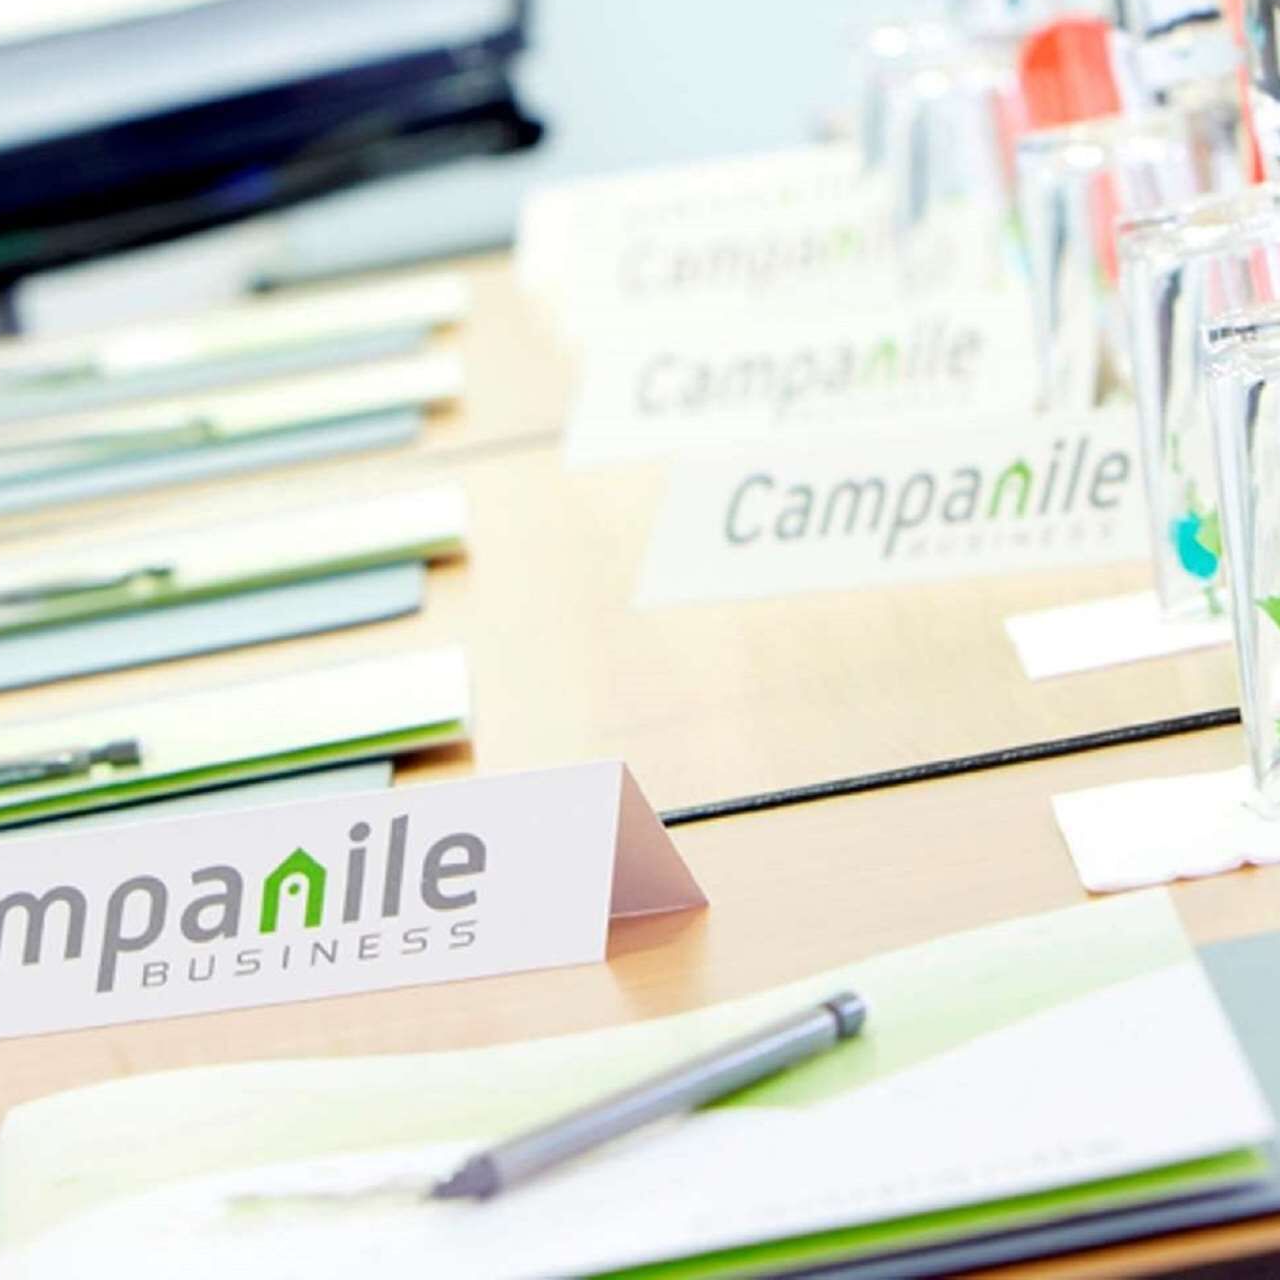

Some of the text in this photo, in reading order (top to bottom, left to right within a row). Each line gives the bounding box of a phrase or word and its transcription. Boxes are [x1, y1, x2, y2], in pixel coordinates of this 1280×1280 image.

[634, 316, 986, 418] Campanile
[723, 435, 1132, 560] Campanile
[142, 919, 479, 989] BUSINESS
